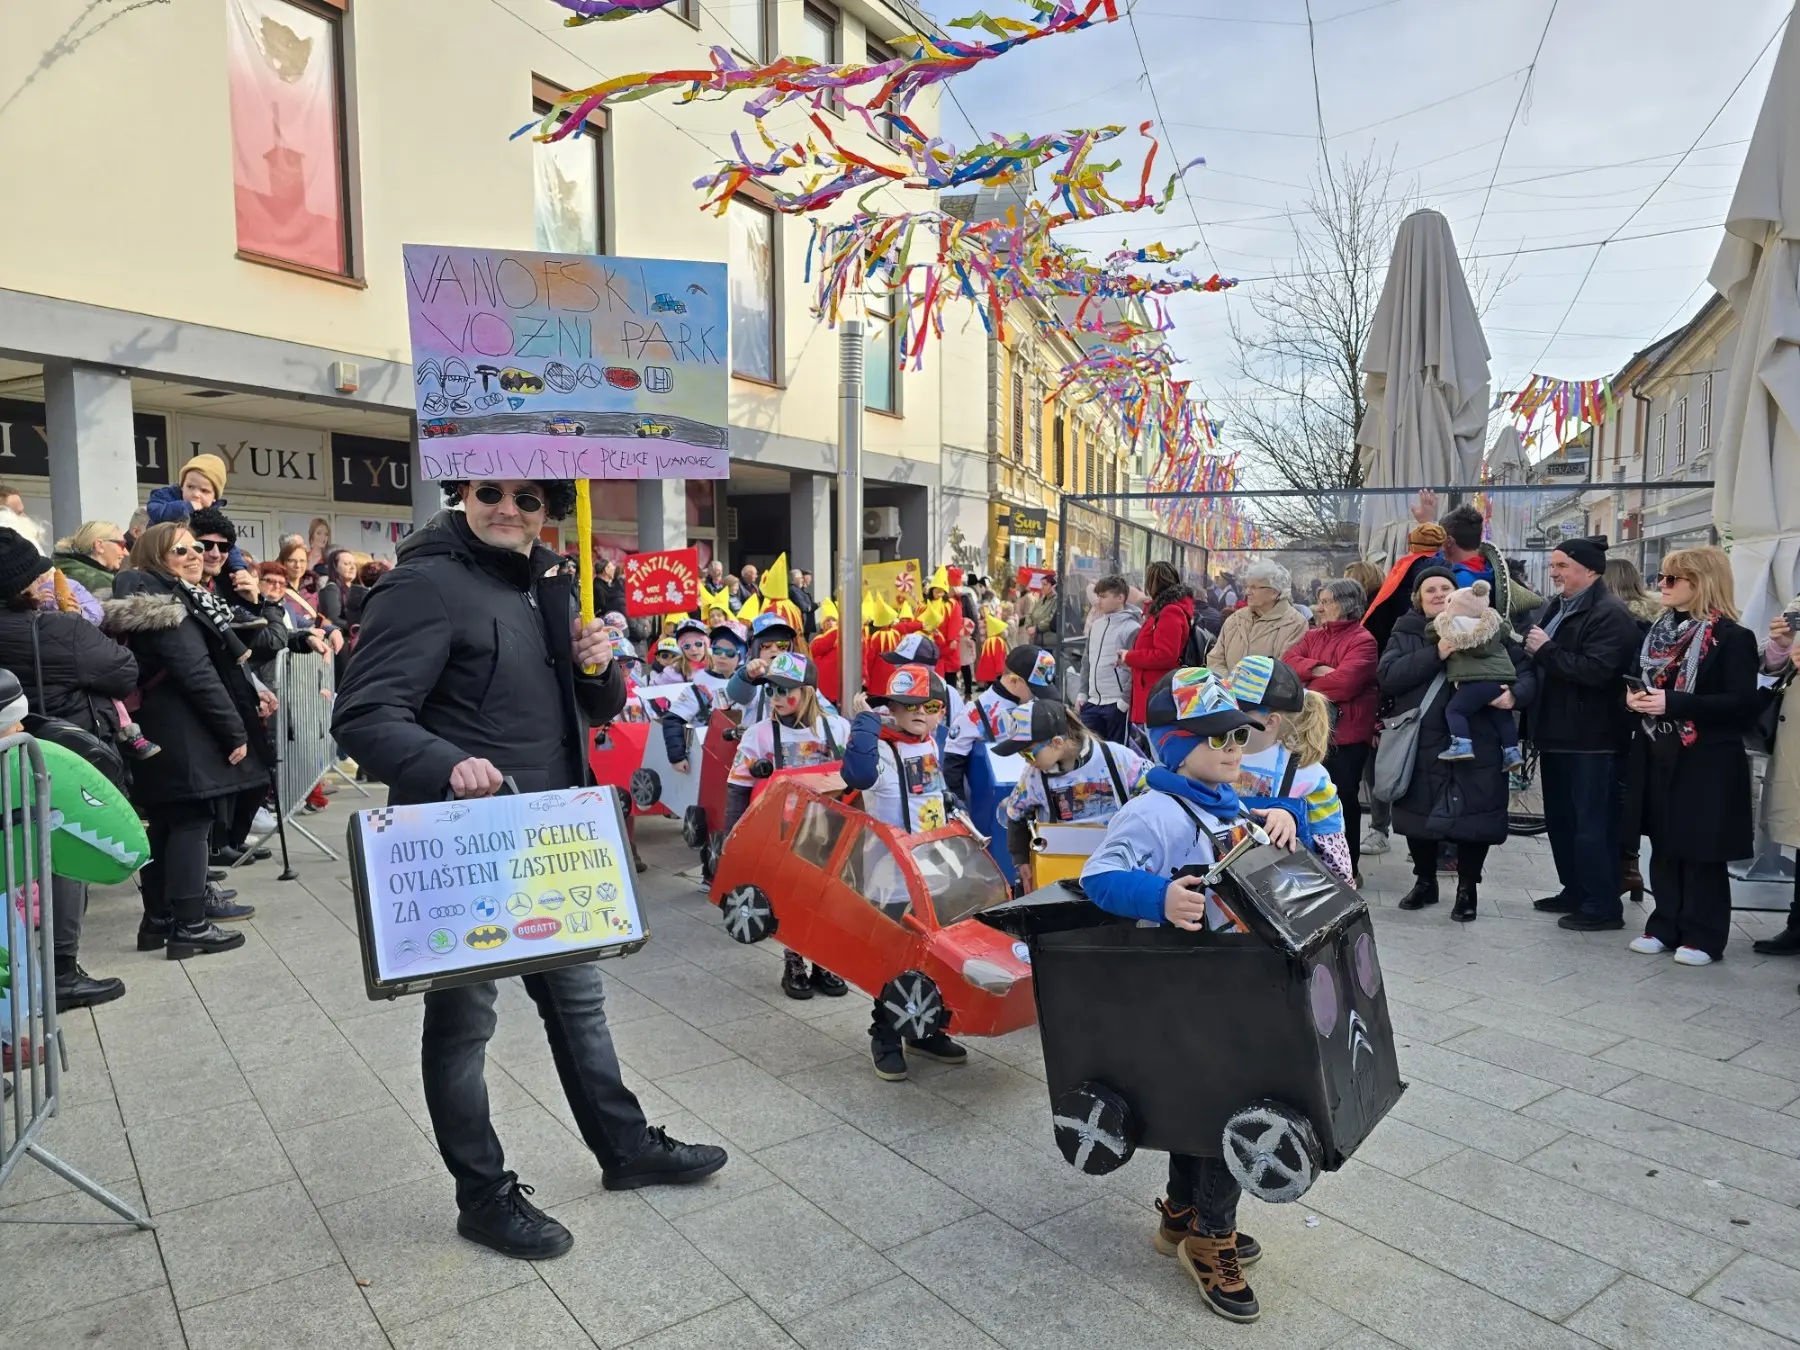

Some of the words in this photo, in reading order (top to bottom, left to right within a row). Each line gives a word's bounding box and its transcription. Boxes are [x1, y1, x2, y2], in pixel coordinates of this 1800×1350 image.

[403, 253, 649, 315] VANOFSKI
[421, 311, 593, 358] VOZNI
[621, 320, 719, 364] PARK
[217, 440, 317, 481] YUKI
[341, 456, 352, 485] I
[1014, 511, 1044, 530] Sun
[390, 838, 443, 864] AUTO
[454, 829, 516, 857] SALON
[525, 820, 599, 848] PČELICE
[389, 860, 499, 895] OVLAŠTENI
[509, 848, 613, 879] ZASTUPNIK
[392, 899, 421, 924] ZA
[517, 921, 557, 936] BUGATTI
